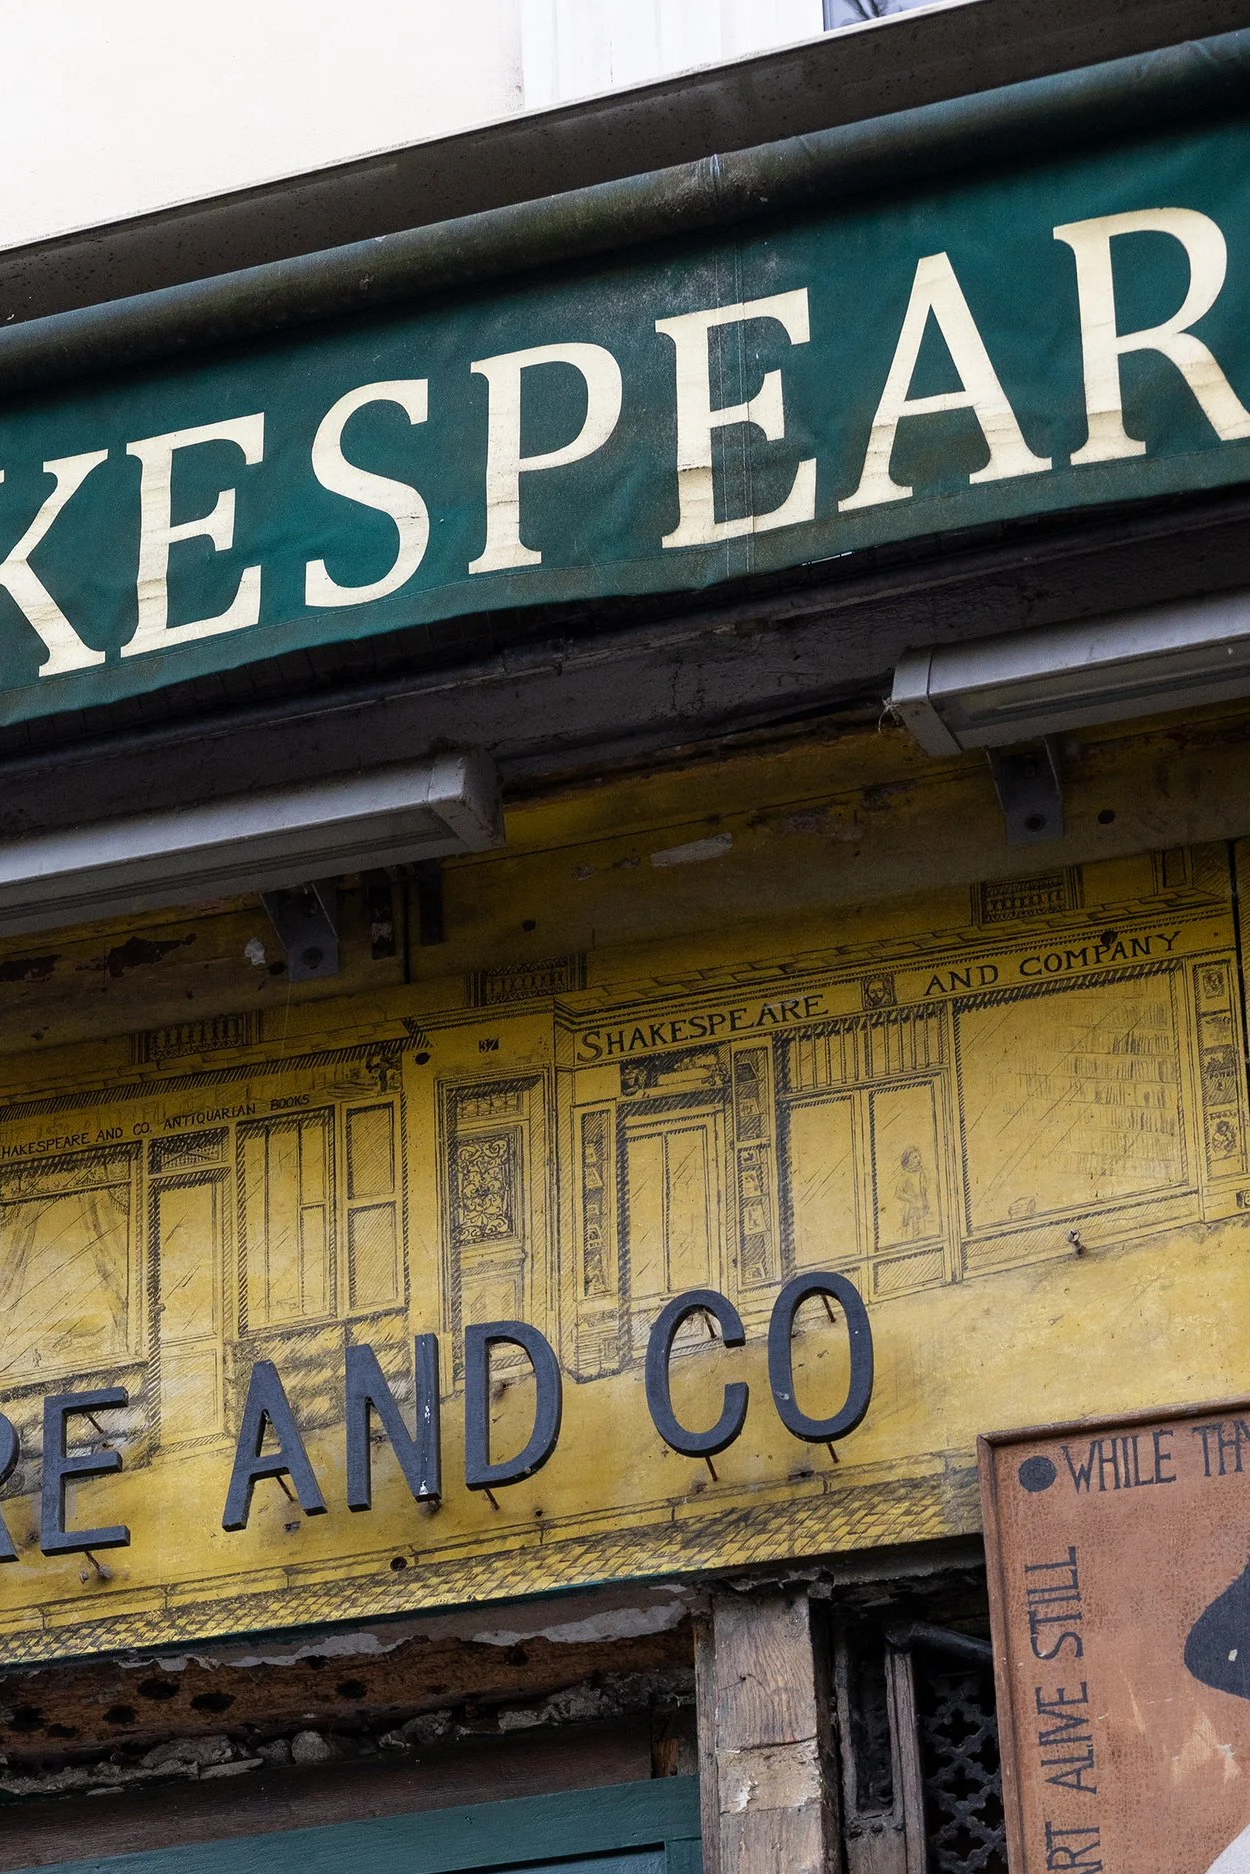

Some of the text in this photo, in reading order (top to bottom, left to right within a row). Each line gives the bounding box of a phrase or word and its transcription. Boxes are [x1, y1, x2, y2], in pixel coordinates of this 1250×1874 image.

[576, 931, 1182, 1063] SHAKESPEARE AND COMPANY
[95, 1127, 124, 1142] AND
[163, 1104, 257, 1131] ANTIQUARIAN
[270, 1093, 311, 1112] BOOKS
[221, 1319, 563, 1533] AND
[648, 1270, 876, 1452] CO
[1060, 1429, 1176, 1494] WHILE
[1025, 1544, 1083, 1661] STILL
[1035, 1680, 1098, 1795] ALIVE
